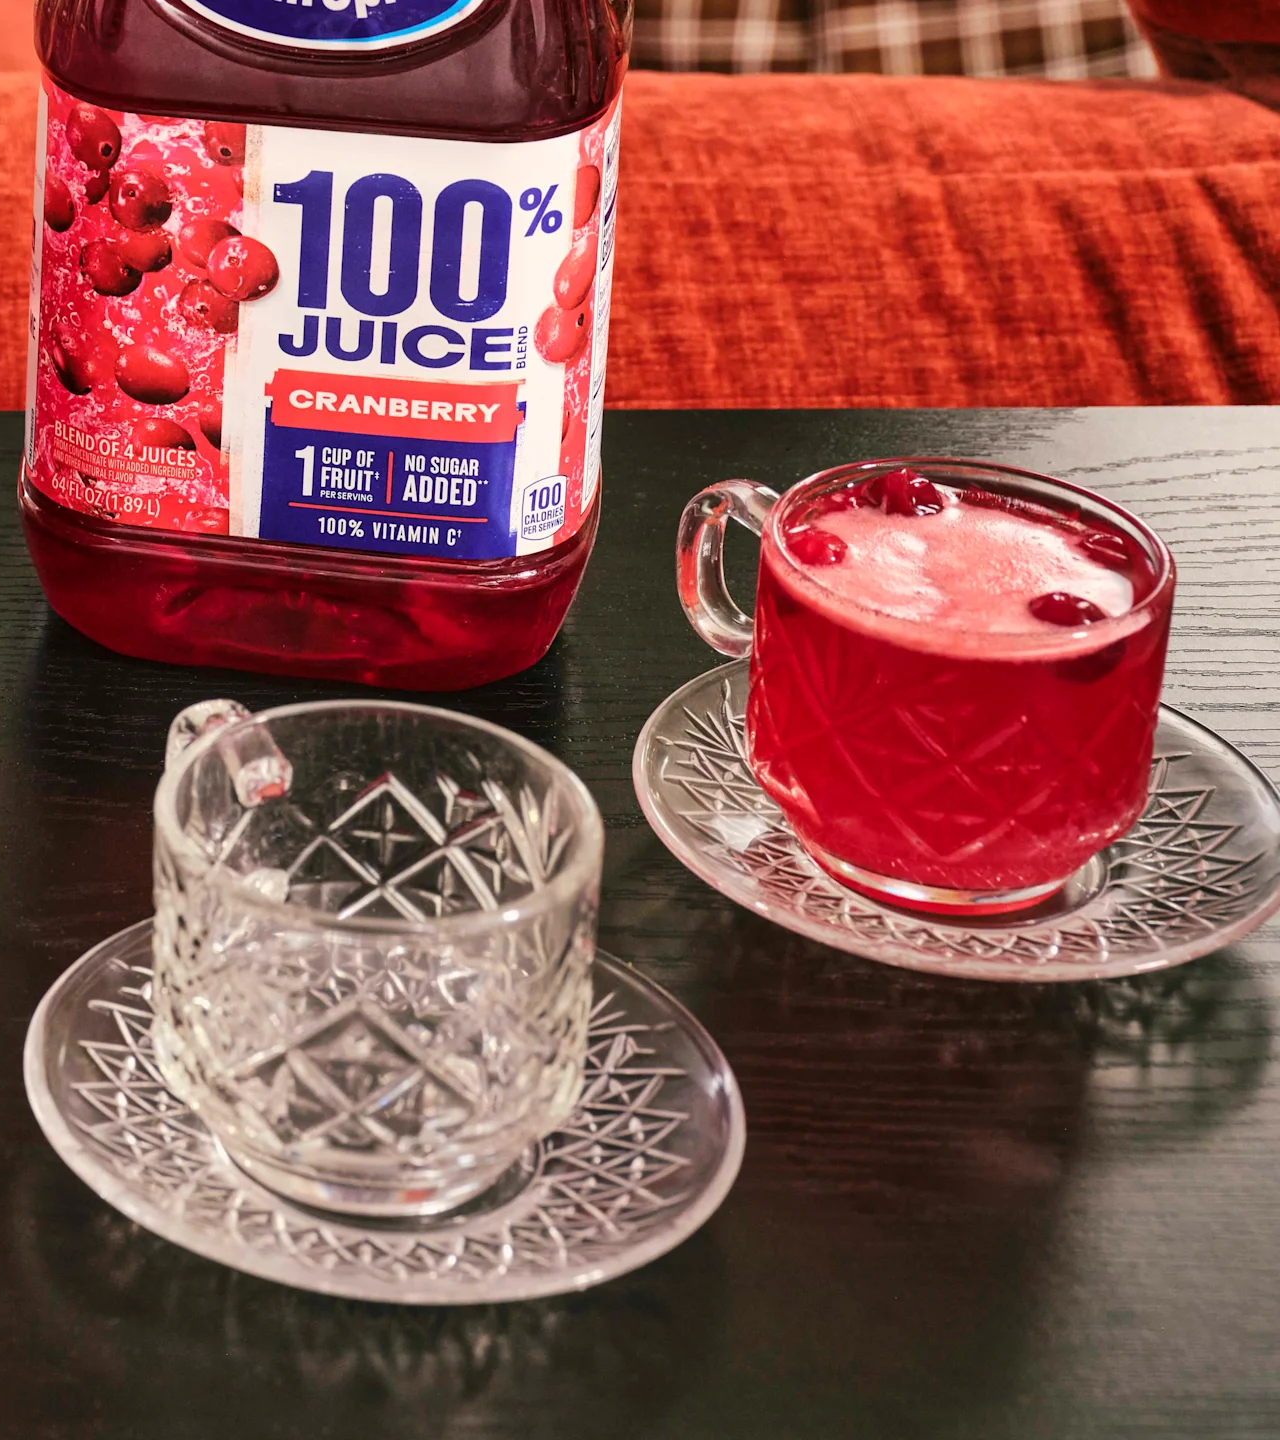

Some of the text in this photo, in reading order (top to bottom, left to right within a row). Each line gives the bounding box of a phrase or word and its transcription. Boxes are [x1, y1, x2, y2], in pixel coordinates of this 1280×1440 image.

[273, 170, 563, 323] 100%
[278, 315, 514, 371] JUICE
[516, 325, 528, 369] BLEND
[289, 389, 500, 423] CRANBERRY
[53, 438, 195, 479] FROM CONCENTRATE WITH ADDED INGREDIENTS
[54, 420, 197, 468] BLEND OF 4 JUICES
[322, 447, 375, 468] CUP OF
[65, 454, 81, 471] OTHER
[81, 463, 107, 480] NATURAL
[108, 469, 134, 484] FLAVOR
[295, 445, 315, 496] 1
[404, 455, 480, 477] NO SUGAR
[51, 473, 161, 518] 64 FL OZ (1.89 L)
[320, 490, 374, 503] PER SERVING
[528, 482, 562, 513] 100
[318, 516, 365, 538] 100%
[372, 521, 439, 545] VITAMIN
[523, 517, 565, 535] PER SERVING
[524, 505, 564, 526] CALORIES
